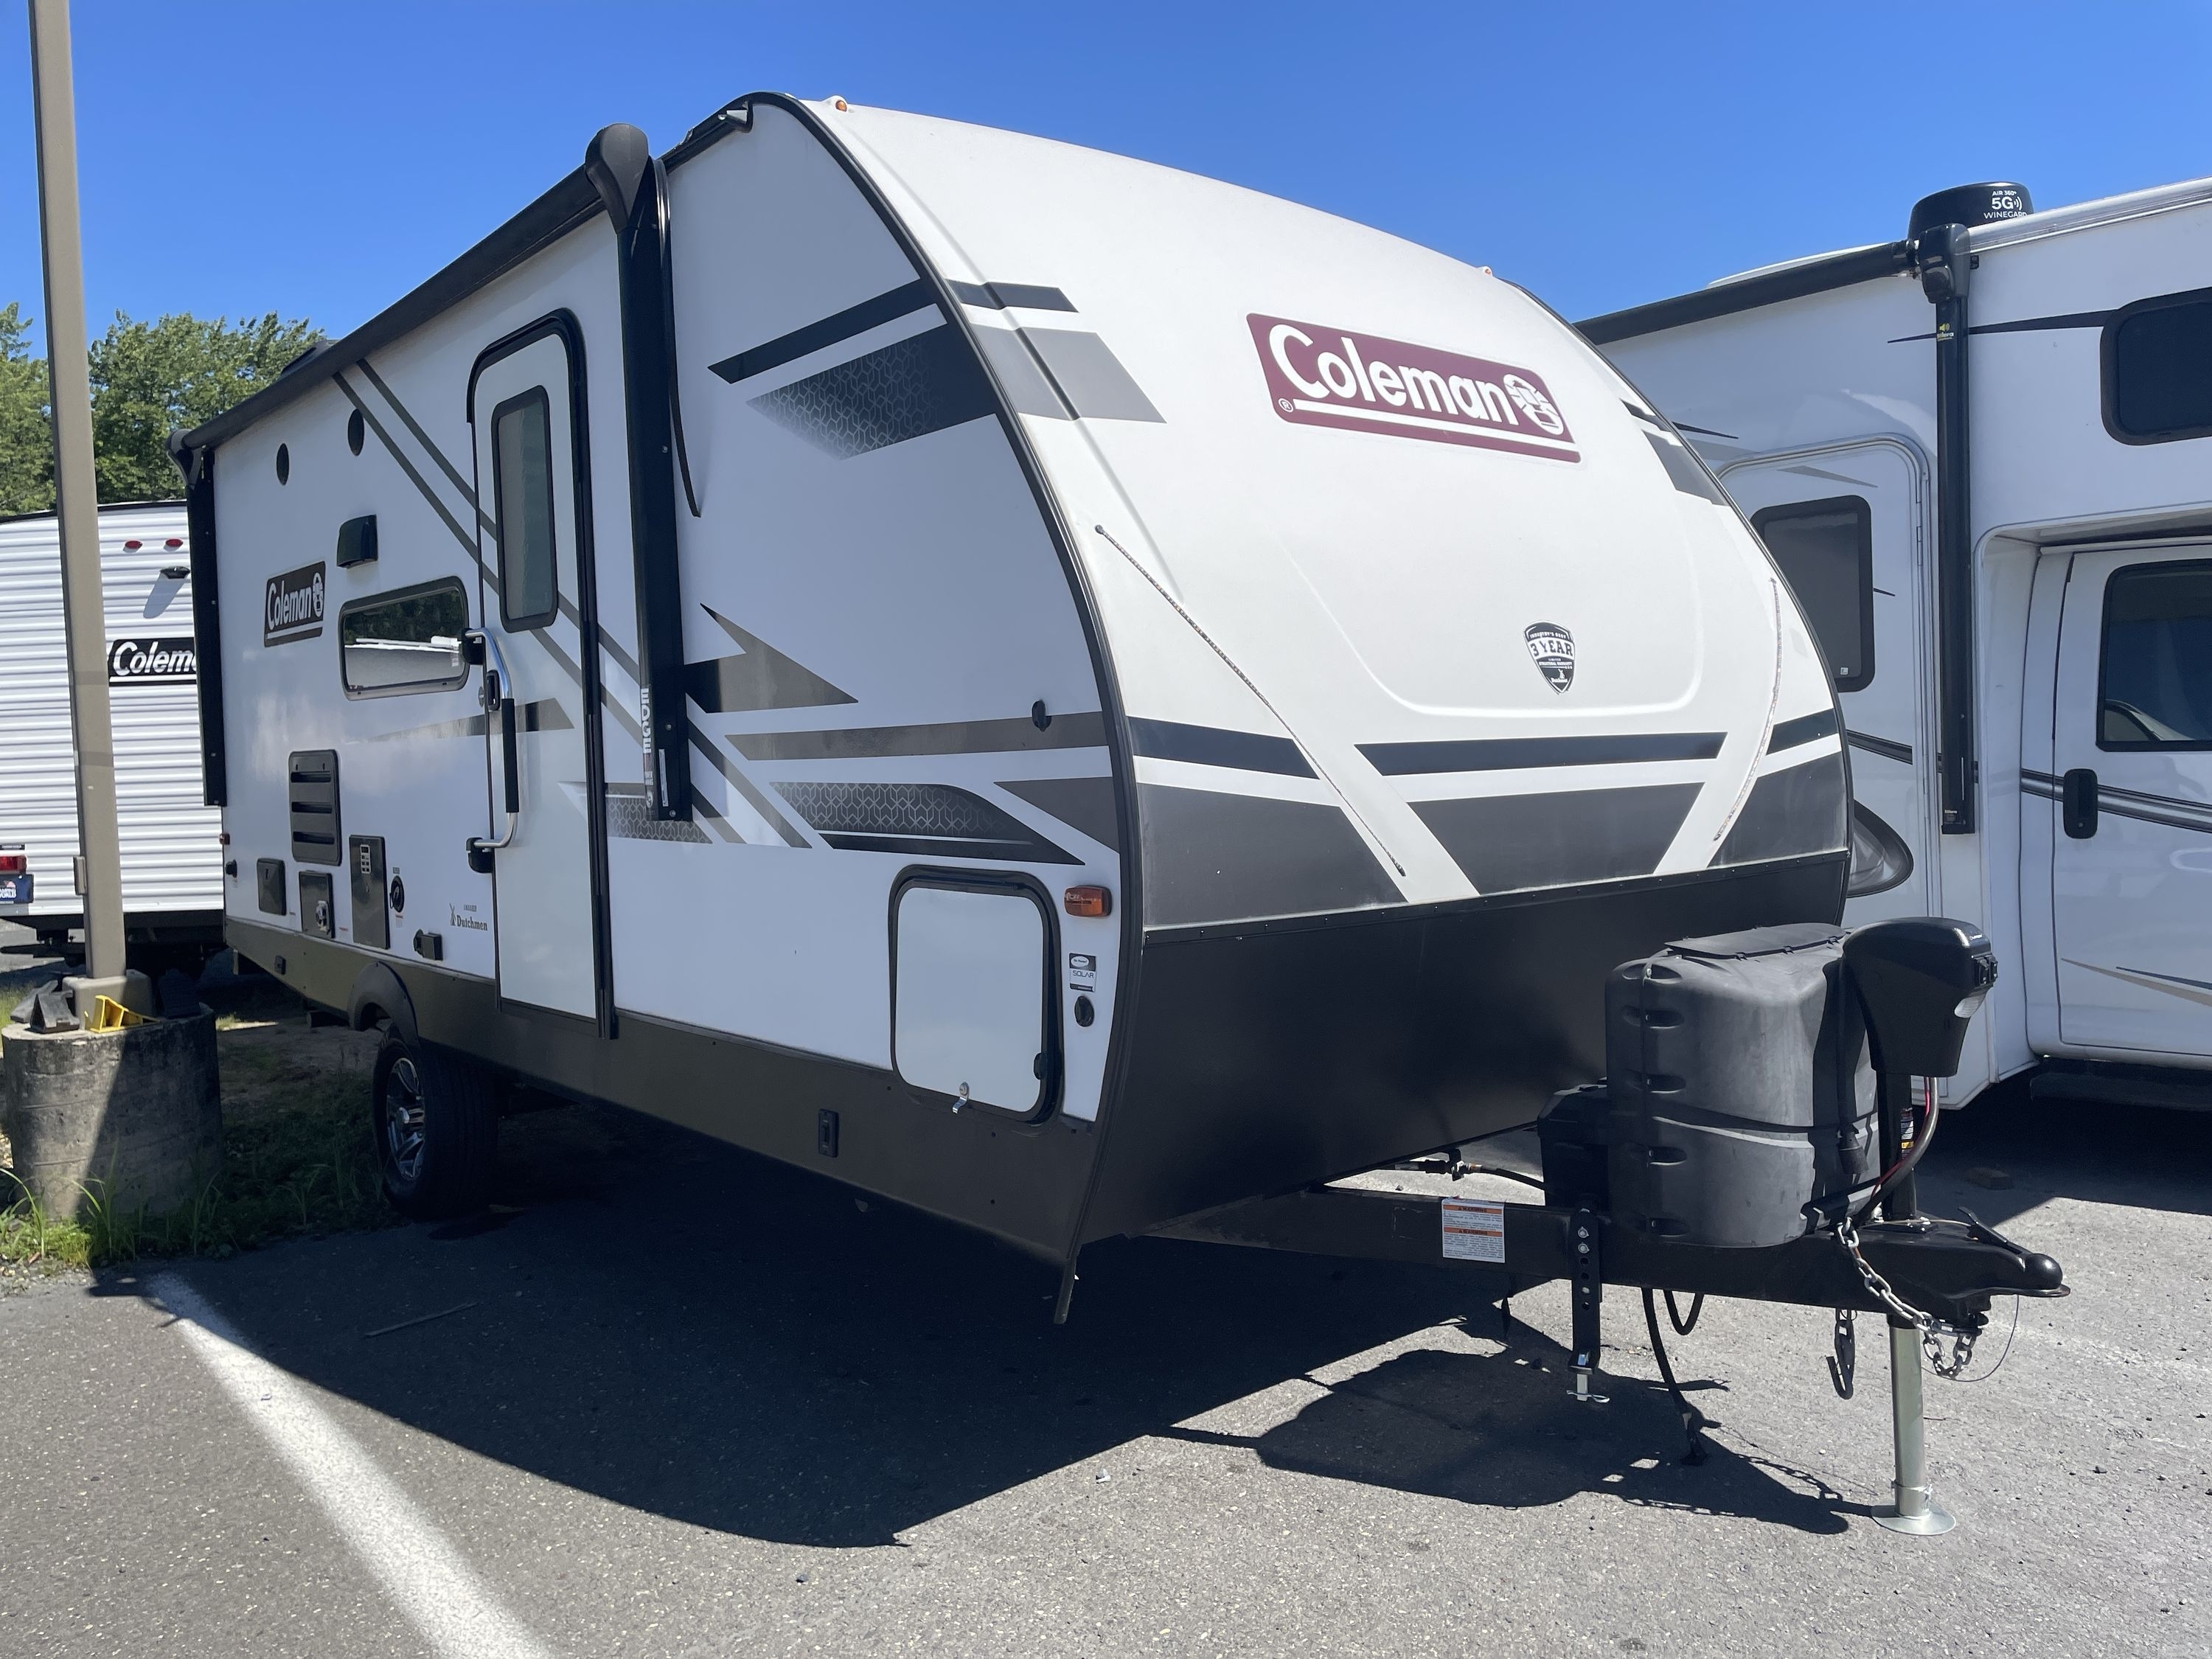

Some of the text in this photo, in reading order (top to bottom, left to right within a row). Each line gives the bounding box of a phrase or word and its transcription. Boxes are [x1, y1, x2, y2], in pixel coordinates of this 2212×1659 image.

[1992, 196, 2014, 209] 5G
[1983, 211, 2028, 219] WINEGARD
[1268, 324, 1519, 426] Coleman
[267, 580, 312, 630] Coleman
[1530, 640, 1573, 657] 3 YEAR
[113, 641, 197, 676] Colem
[641, 688, 652, 754] EDGE
[456, 914, 488, 931] Dutchmen
[1072, 970, 1094, 978] SOLAR
